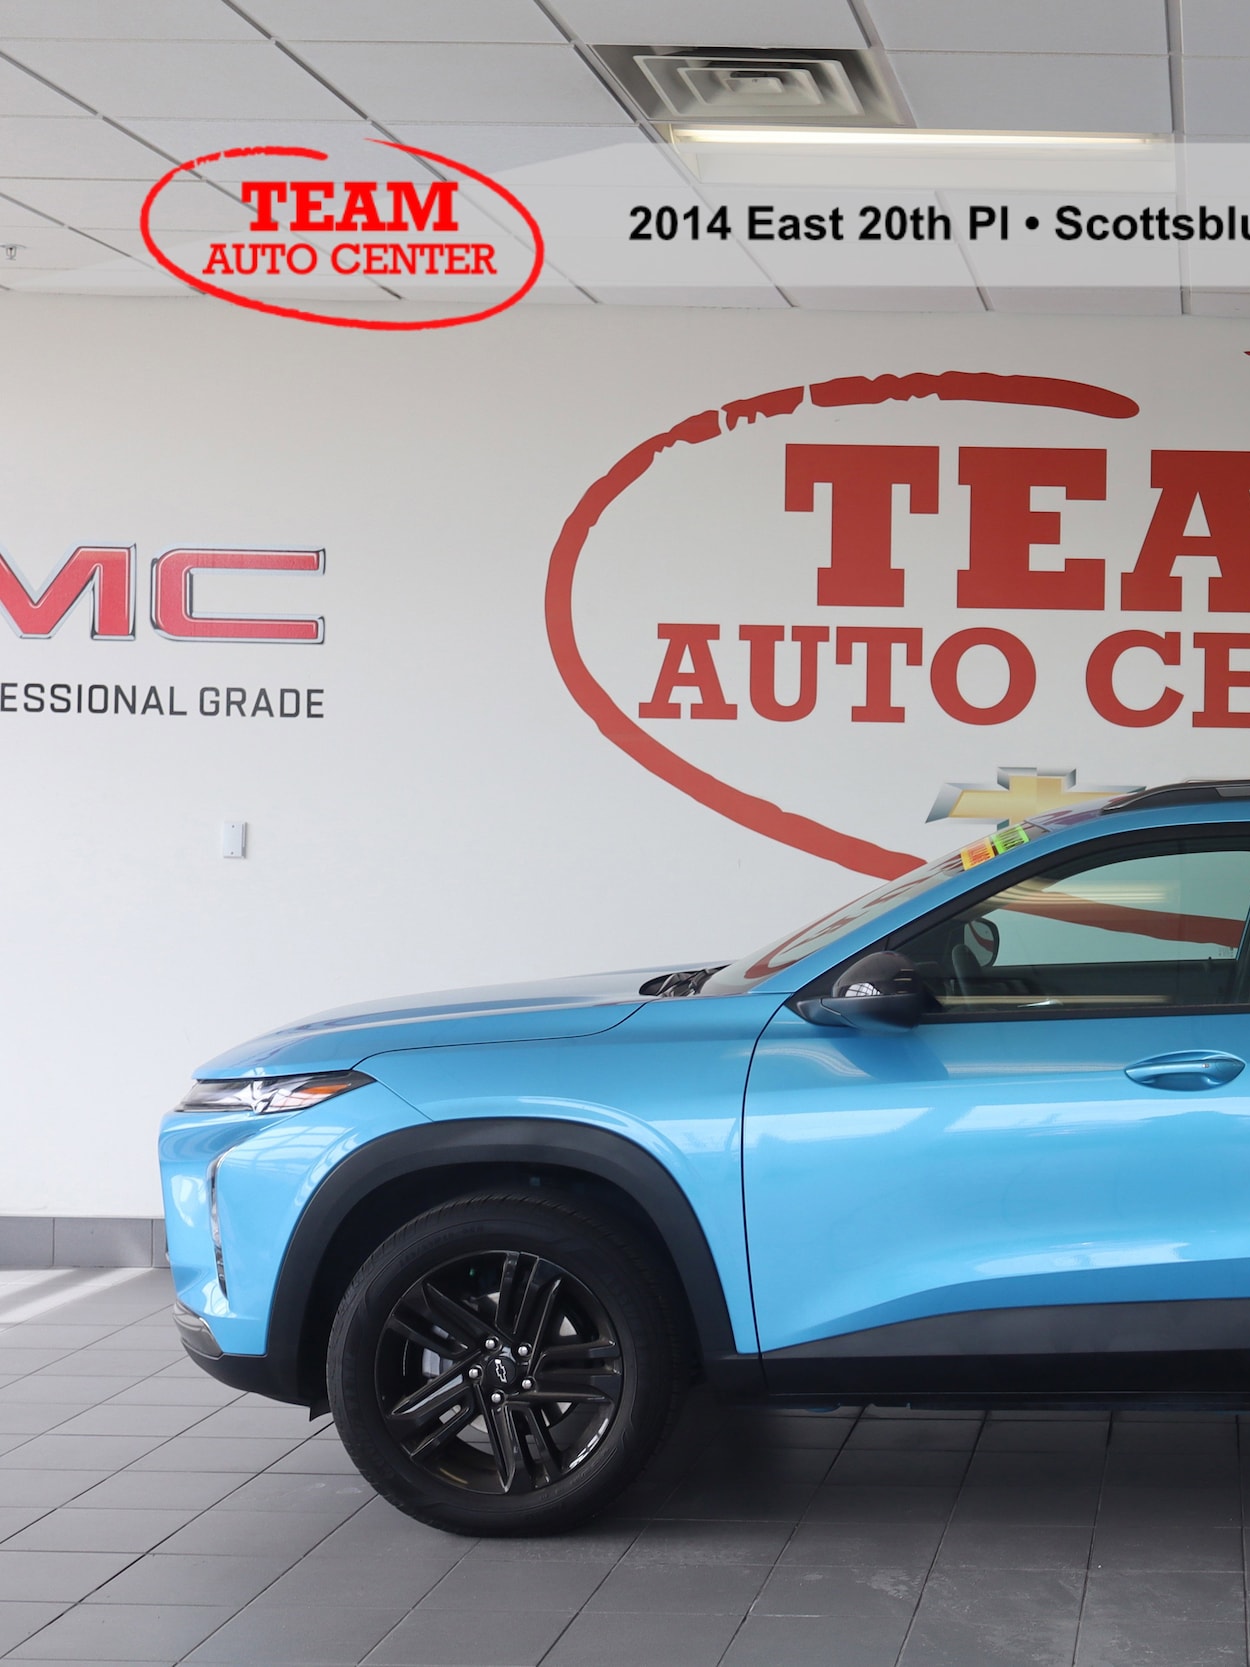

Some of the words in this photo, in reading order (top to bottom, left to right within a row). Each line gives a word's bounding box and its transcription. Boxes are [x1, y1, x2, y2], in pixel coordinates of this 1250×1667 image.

[0, 682, 188, 716] ESSIONAL
[199, 686, 325, 719] GRADE
[637, 622, 1037, 727] AUTO
